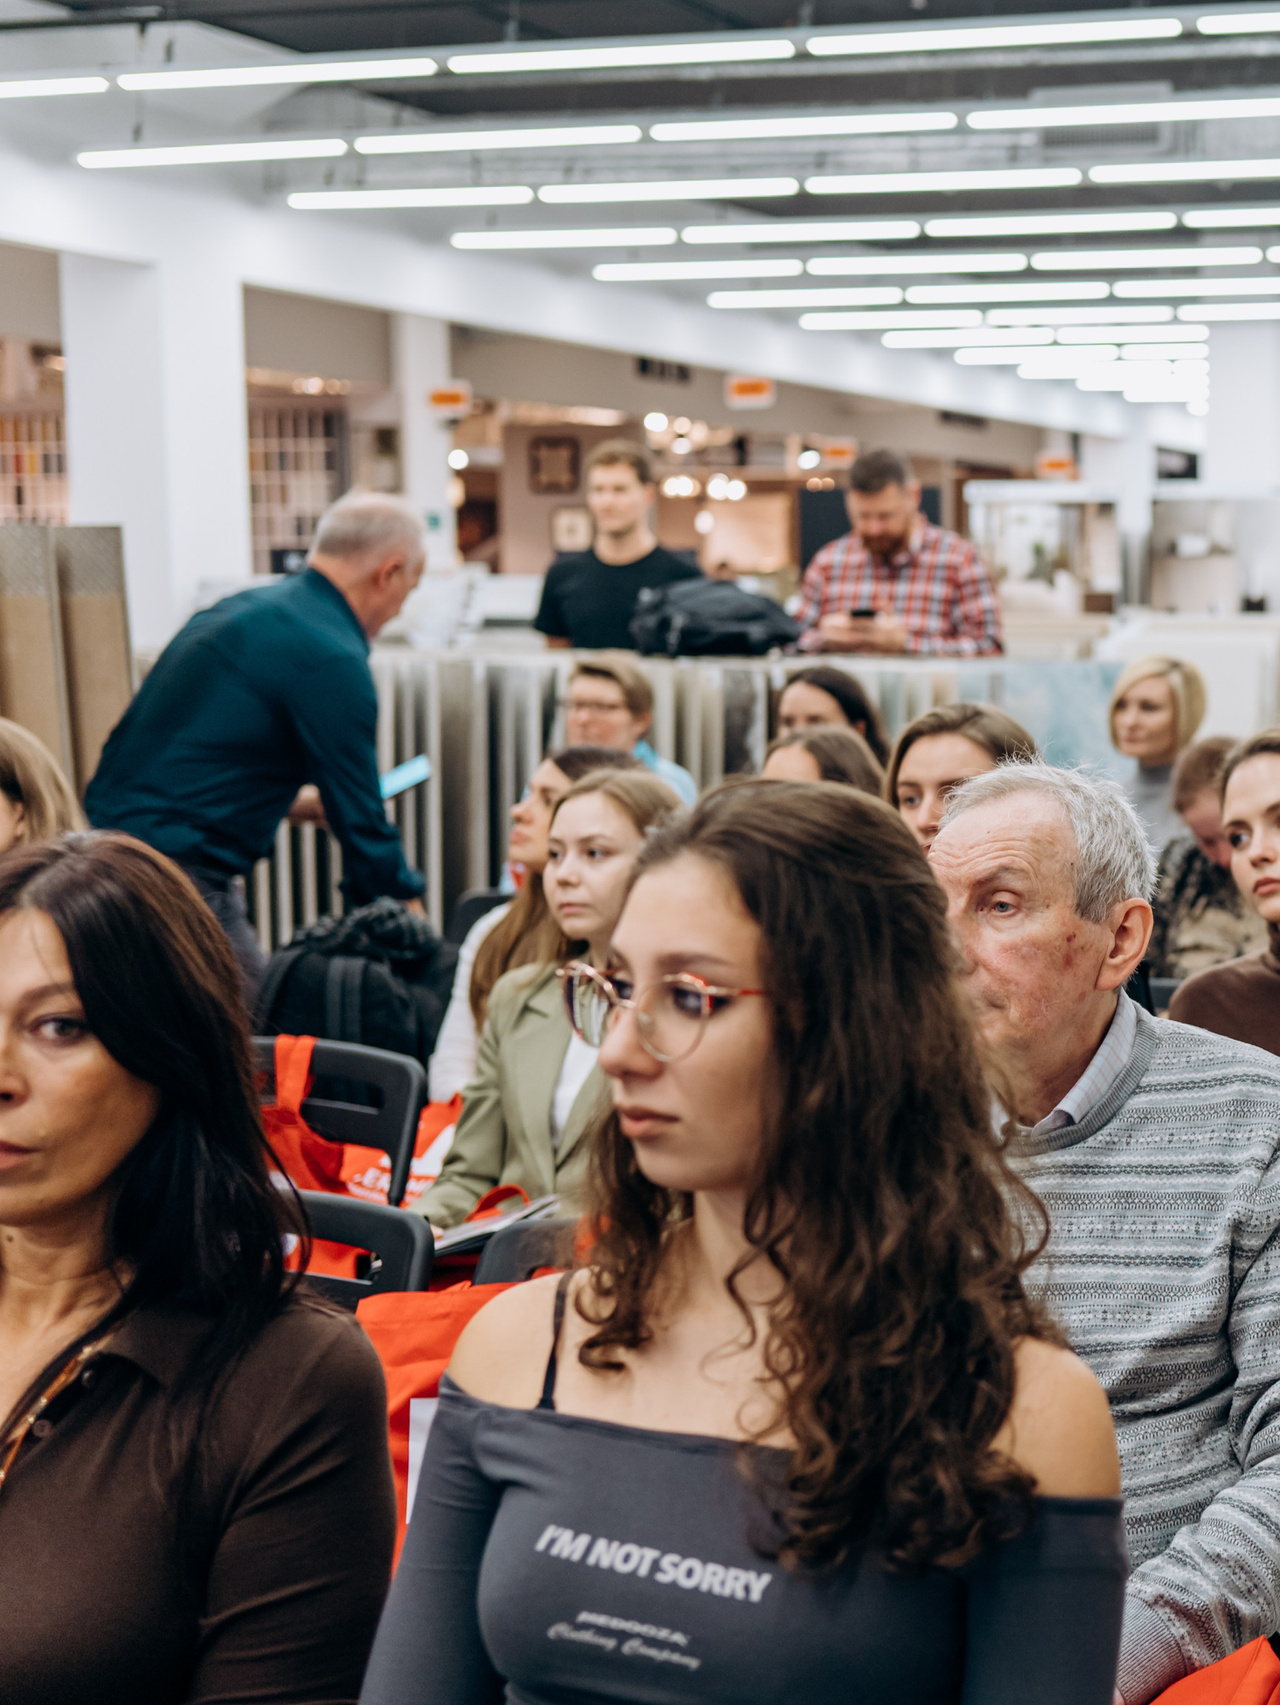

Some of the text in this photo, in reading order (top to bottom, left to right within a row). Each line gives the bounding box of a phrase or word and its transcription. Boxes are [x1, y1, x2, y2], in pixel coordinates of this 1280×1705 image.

[535, 1524, 773, 1603] I'M NOT SORRY
[621, 1637, 702, 1671] Company
